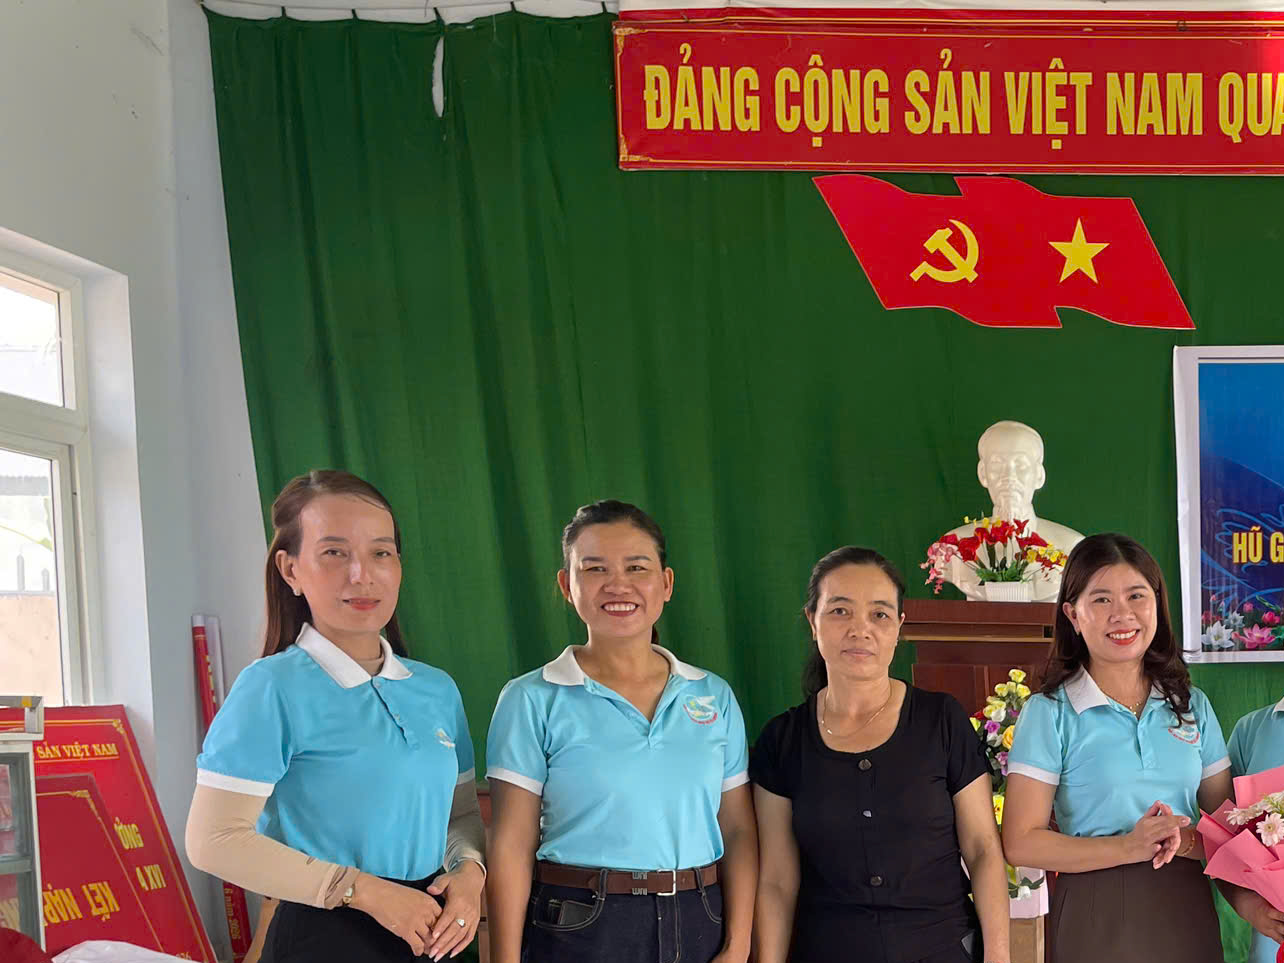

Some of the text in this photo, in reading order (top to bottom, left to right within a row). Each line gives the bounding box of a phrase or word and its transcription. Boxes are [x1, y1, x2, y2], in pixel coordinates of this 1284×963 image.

[643, 43, 761, 132] ĐẢNG
[775, 54, 890, 148] CỘNG
[904, 48, 991, 136] SẢN
[1003, 57, 1093, 150] VIỆT
[1106, 72, 1203, 136] NAM
[1232, 526, 1264, 564] HŨ
[62, 741, 91, 760] VIỆT
[92, 743, 119, 756] NAM
